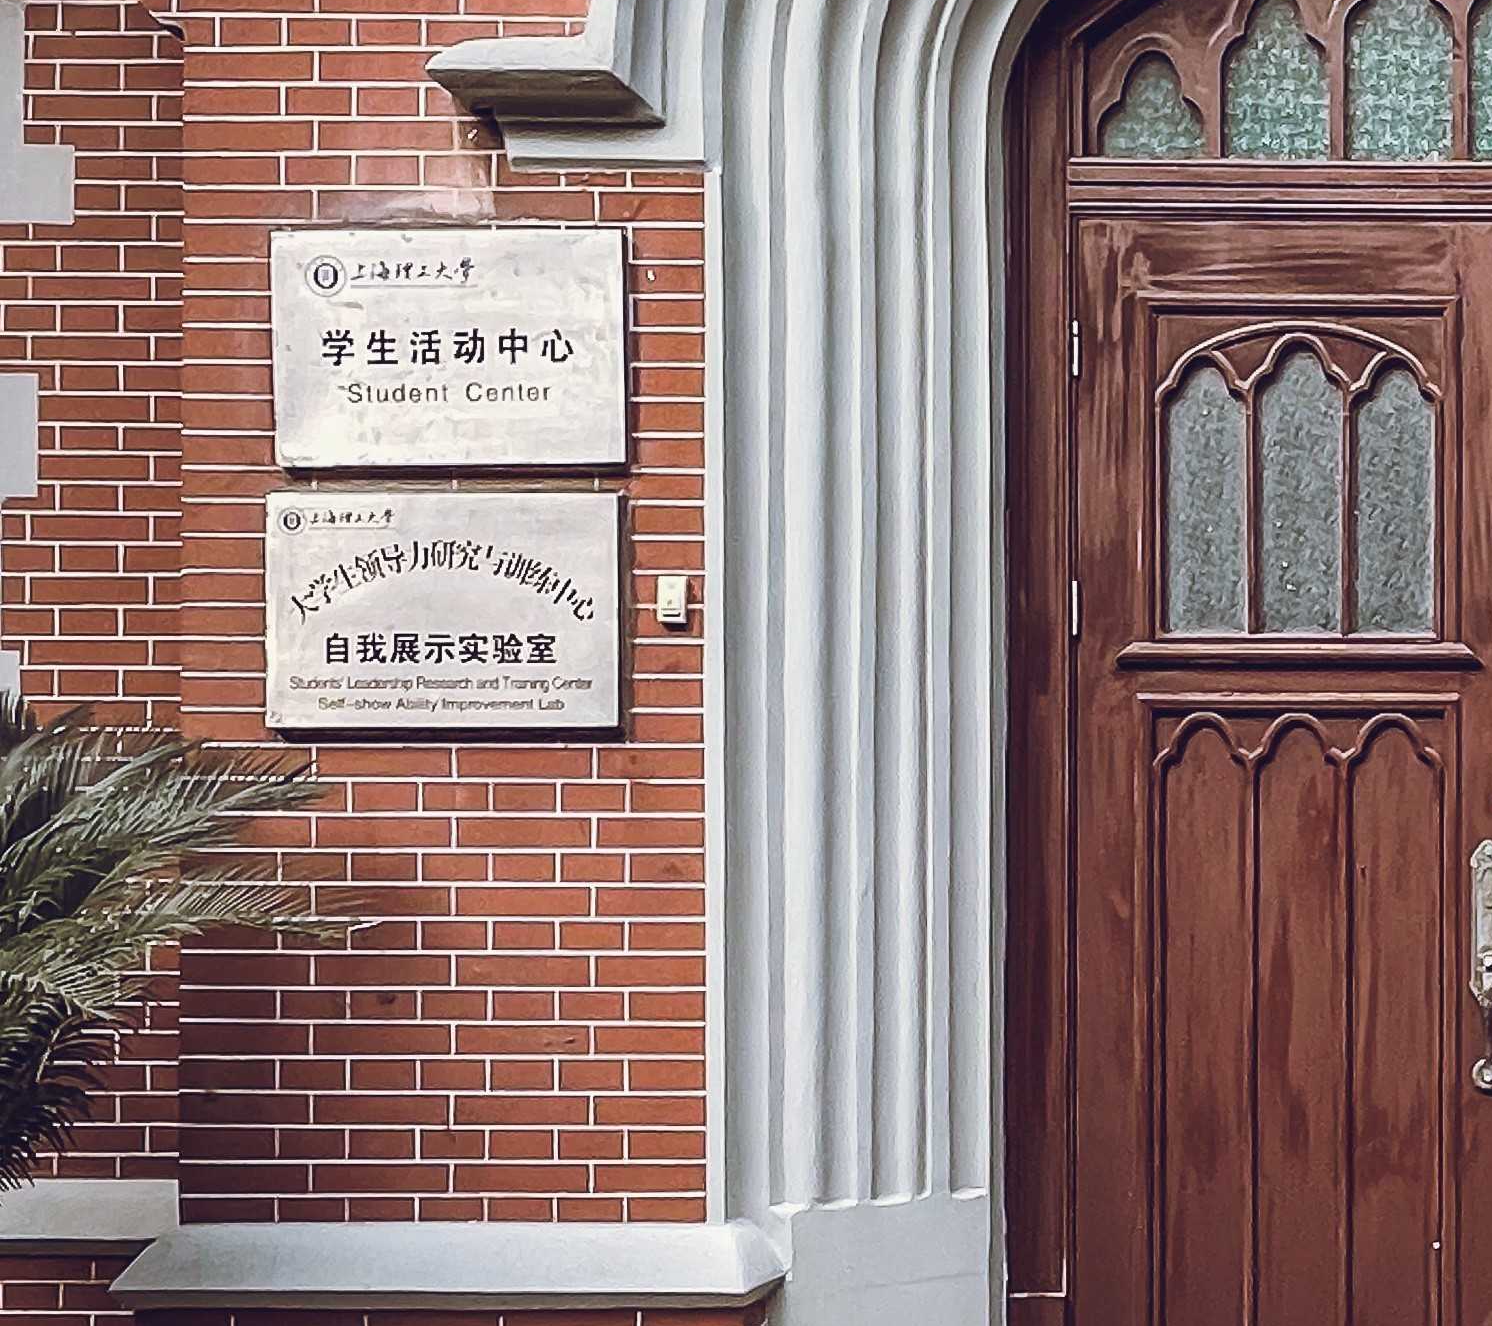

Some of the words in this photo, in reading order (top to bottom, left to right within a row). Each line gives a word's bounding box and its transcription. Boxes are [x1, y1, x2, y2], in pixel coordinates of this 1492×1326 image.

[322, 328, 575, 366] 学生活动中心
[347, 383, 449, 403] Student
[466, 383, 551, 403] Center
[291, 539, 595, 625] 大学生领导力研究与训练中心
[325, 633, 557, 665] 自我展示实验室
[442, 698, 533, 712] Improvement
[539, 699, 565, 710] Lab
